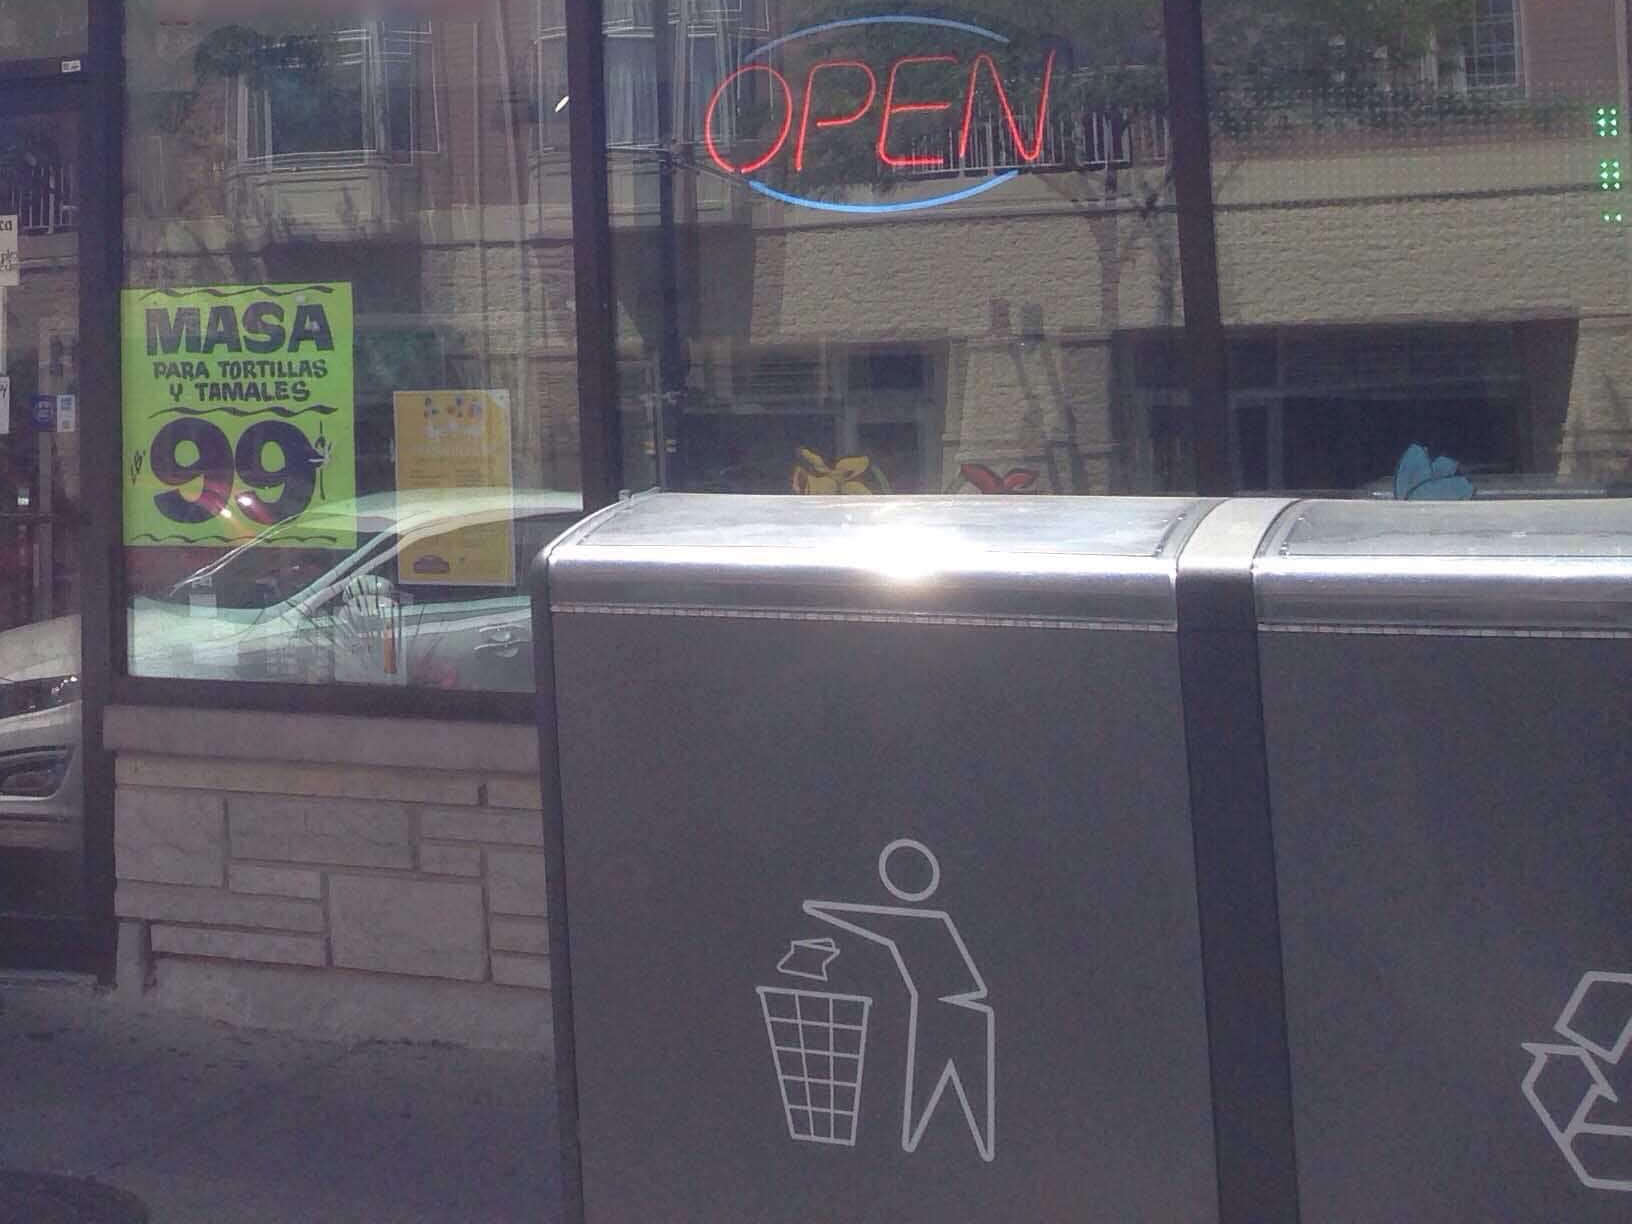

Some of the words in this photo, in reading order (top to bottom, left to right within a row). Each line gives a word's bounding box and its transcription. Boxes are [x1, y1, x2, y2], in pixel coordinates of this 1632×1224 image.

[705, 48, 1057, 173] OPEN
[144, 301, 335, 356] MASA
[153, 360, 210, 380] PARA
[218, 359, 328, 380] TORTILLAS
[169, 383, 184, 402] Y
[194, 380, 311, 402] TAMALES
